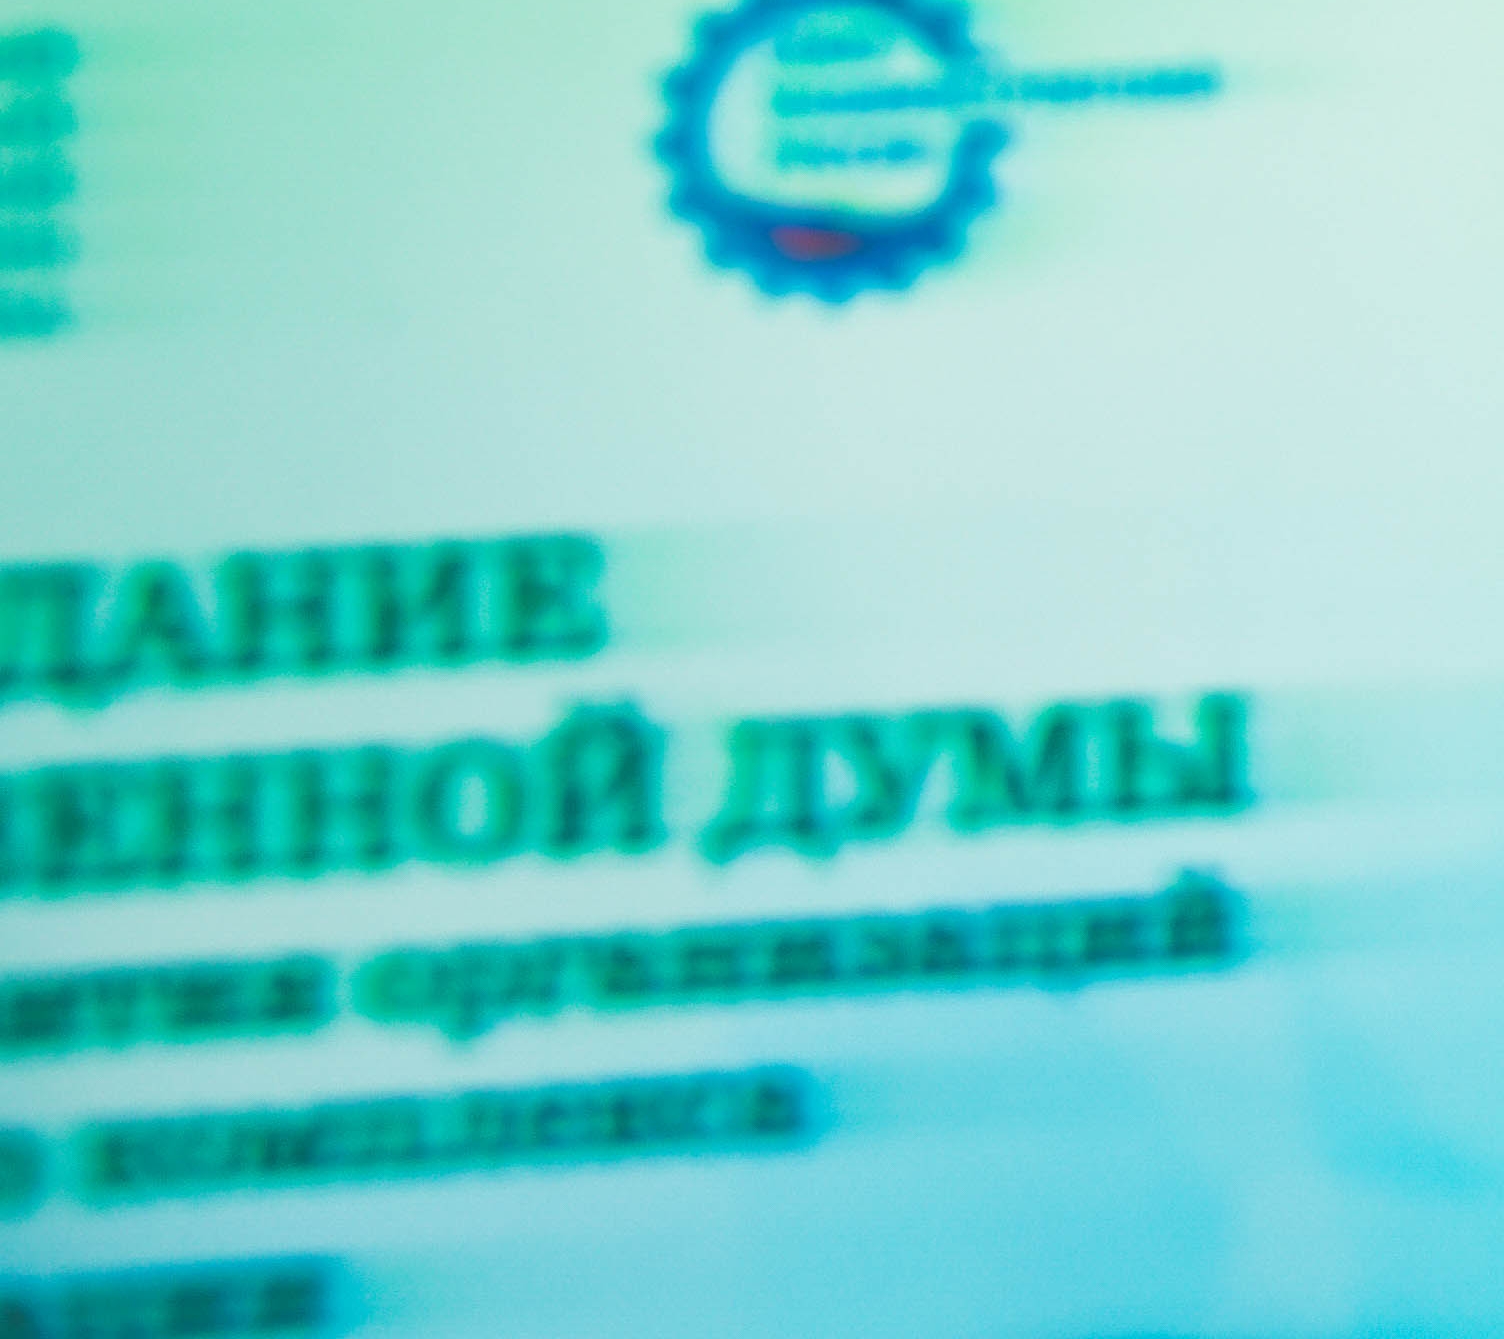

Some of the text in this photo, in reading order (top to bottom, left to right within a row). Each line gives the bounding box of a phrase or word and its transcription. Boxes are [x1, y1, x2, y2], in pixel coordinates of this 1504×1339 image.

[0, 690, 1252, 899] ЕННОЙ ДУМЫ
[354, 869, 1246, 1053] организаций
[70, 1063, 820, 1209] комплекса
